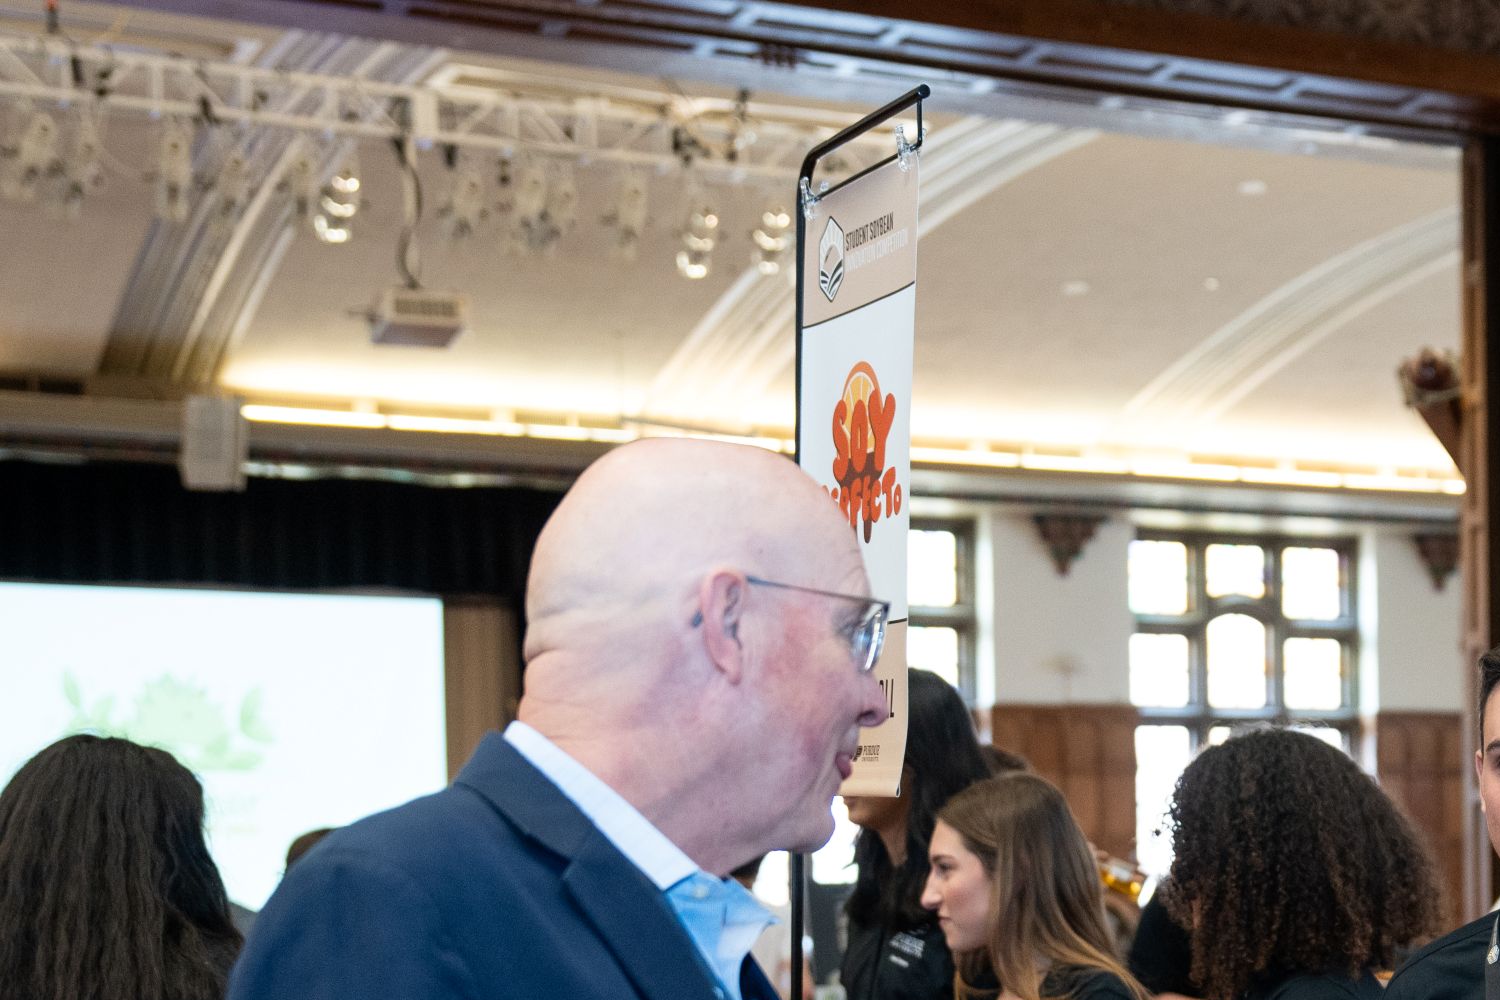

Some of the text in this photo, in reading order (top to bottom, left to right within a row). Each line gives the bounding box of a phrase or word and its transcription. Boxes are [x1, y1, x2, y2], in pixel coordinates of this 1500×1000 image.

[846, 224, 869, 251] STUDENT
[869, 211, 894, 240] SOYBEAN
[833, 389, 896, 481] SOY
[822, 466, 902, 528] RFECTO
